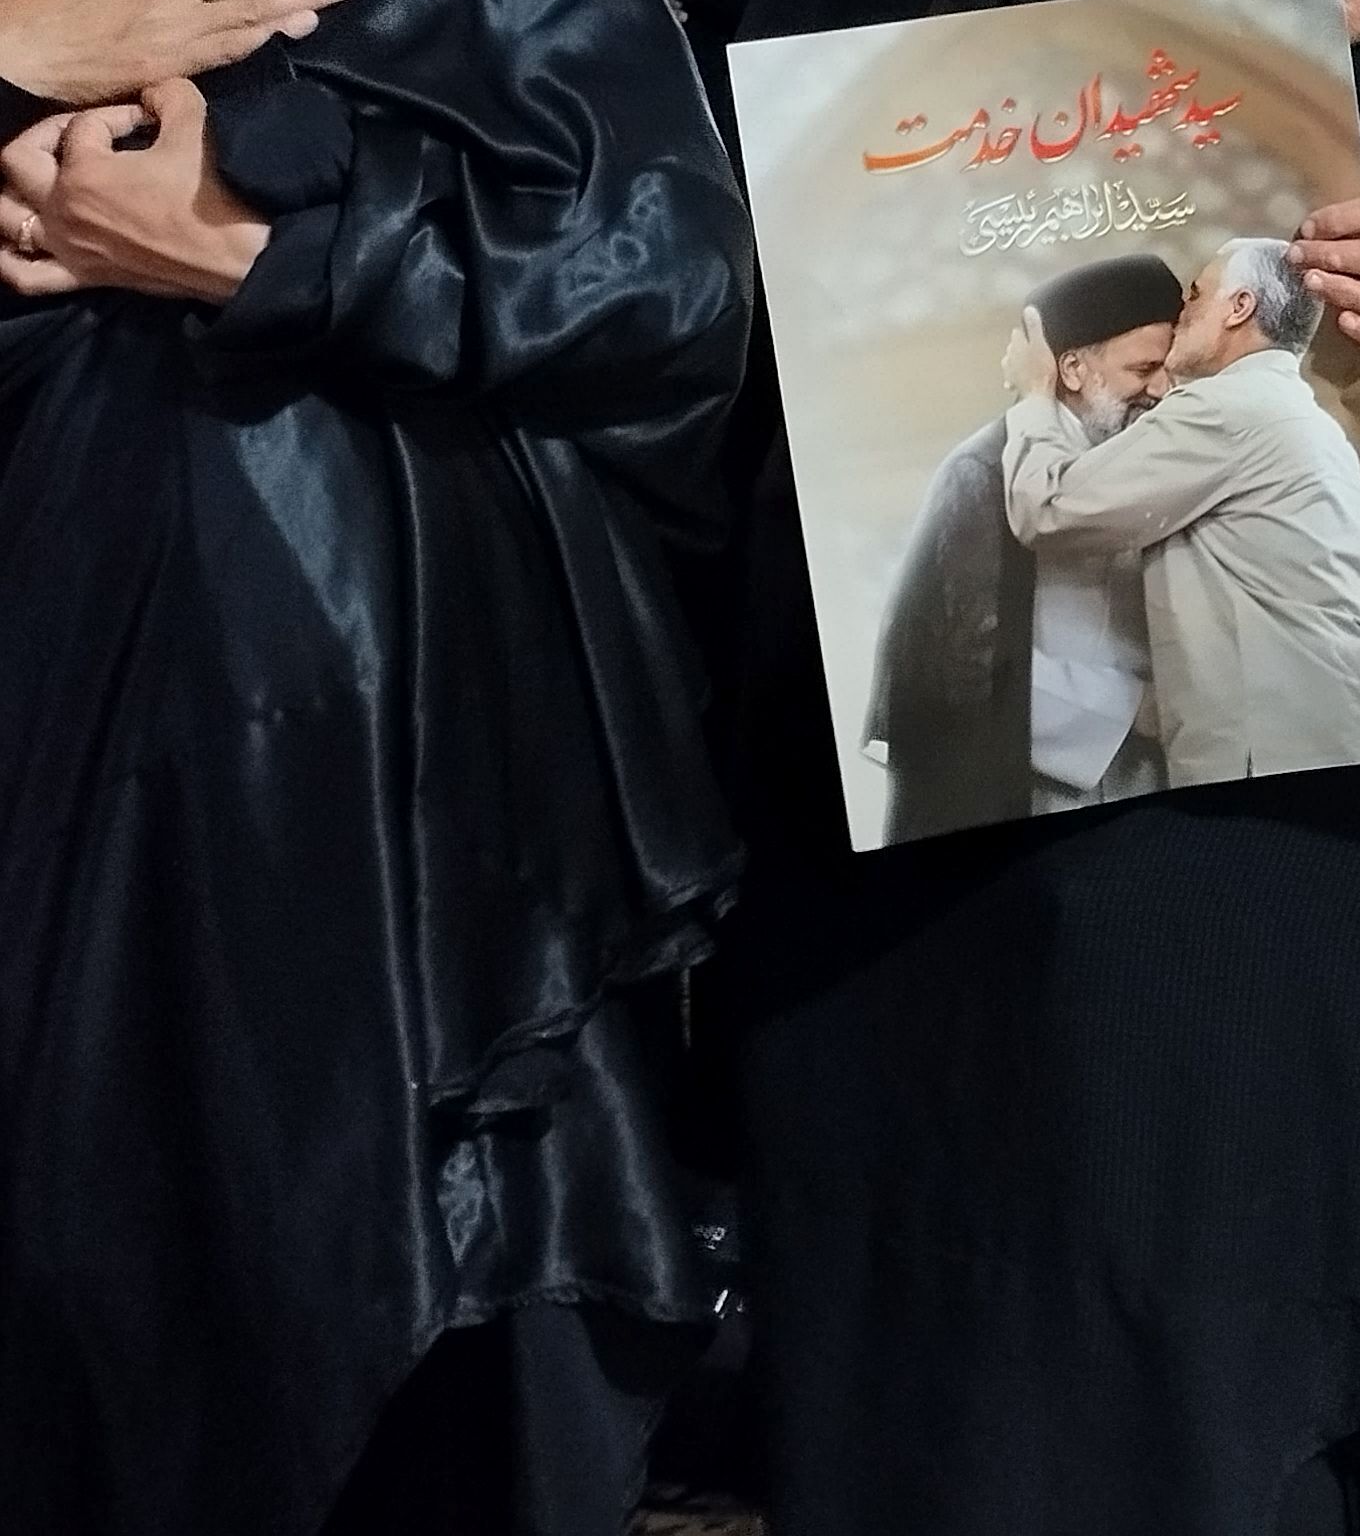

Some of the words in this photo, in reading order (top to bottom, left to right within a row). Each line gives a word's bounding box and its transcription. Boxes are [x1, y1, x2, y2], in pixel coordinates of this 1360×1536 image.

[863, 95, 1022, 174] خدمت
[1031, 48, 1200, 163] شهیدان
[1171, 91, 1243, 149] سید
